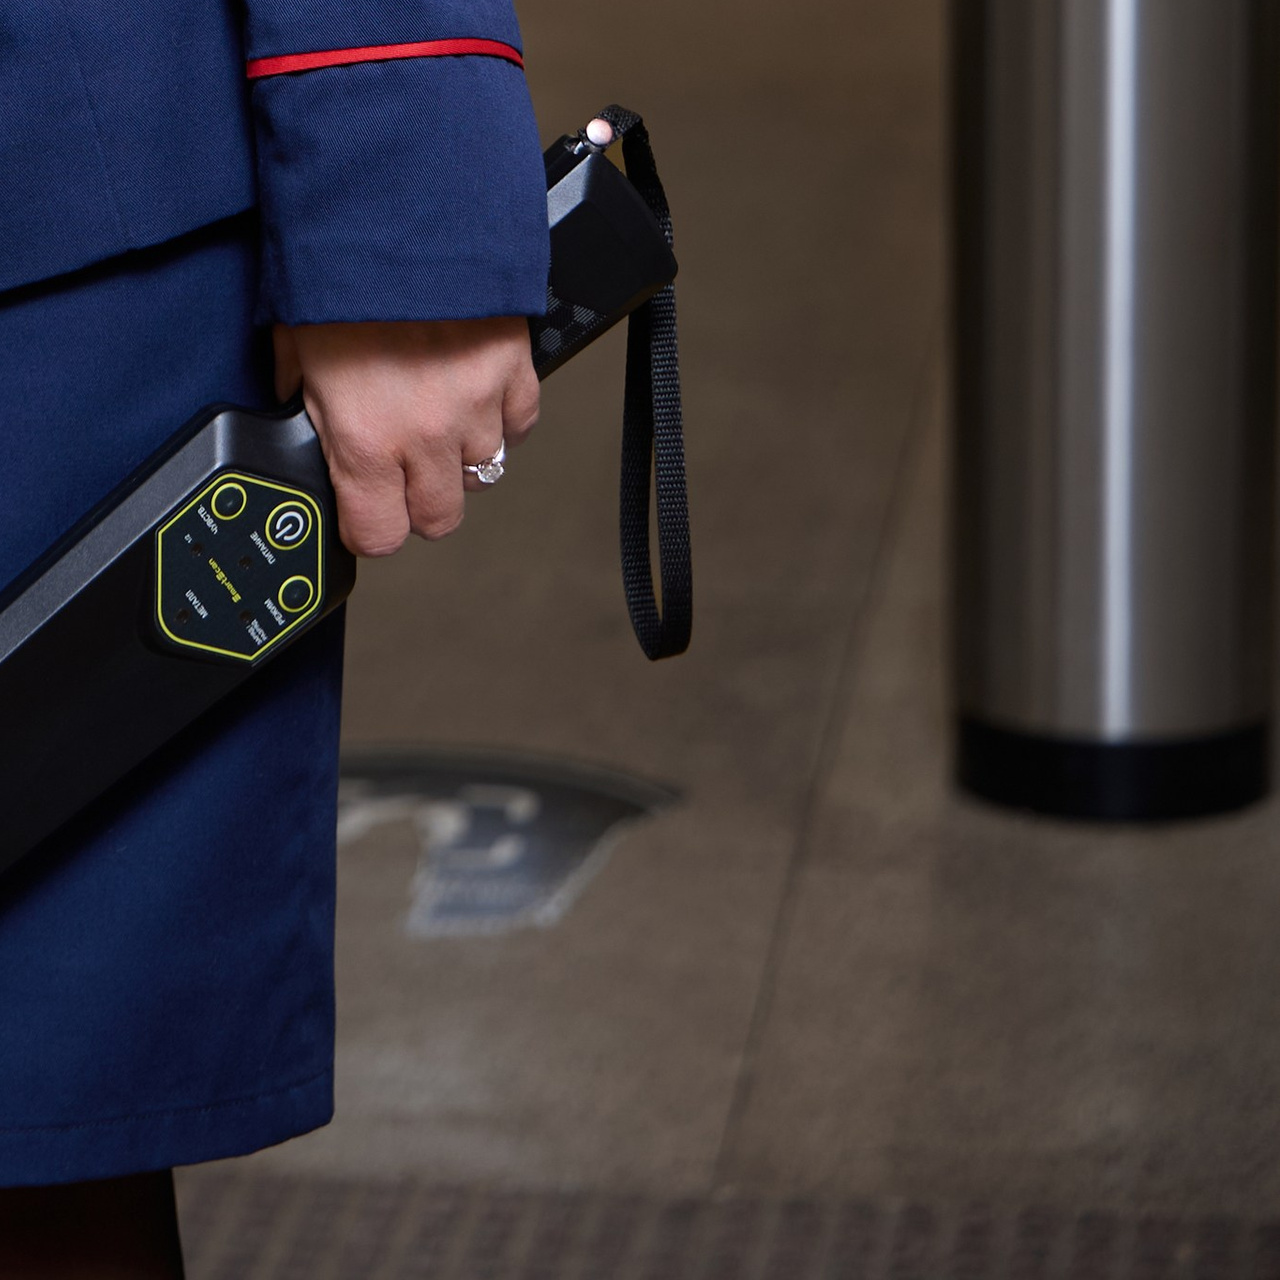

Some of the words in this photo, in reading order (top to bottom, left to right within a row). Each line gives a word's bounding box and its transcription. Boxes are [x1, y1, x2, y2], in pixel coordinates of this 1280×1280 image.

[197, 504, 219, 535] ЧУВСТВ.
[249, 530, 276, 566] ПИТАНИЕ
[208, 557, 242, 604] SmartScan
[185, 589, 208, 619] МЕТАЛЛ
[263, 597, 286, 626] РЕЖИМ
